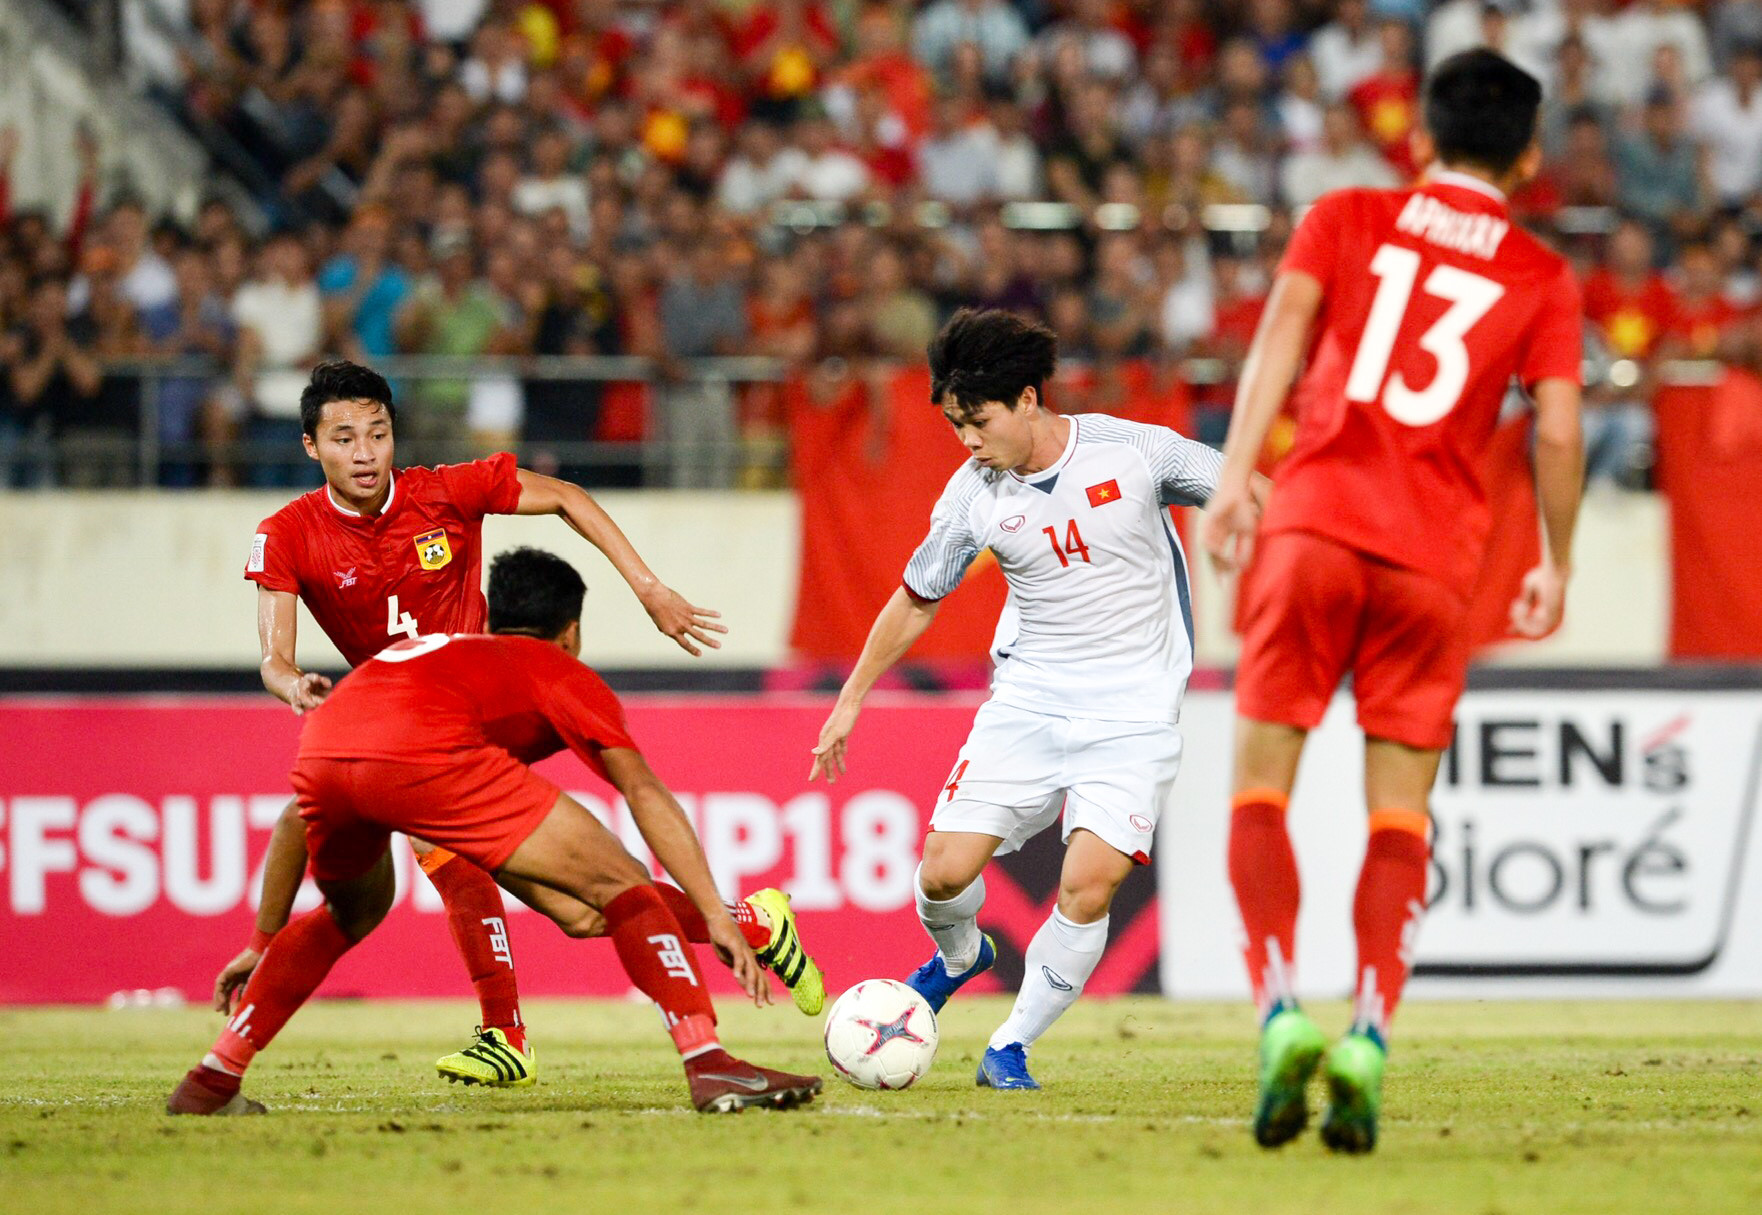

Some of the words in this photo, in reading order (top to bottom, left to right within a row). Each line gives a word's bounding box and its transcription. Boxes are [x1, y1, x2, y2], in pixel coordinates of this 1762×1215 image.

[1344, 243, 1506, 427] 13
[1042, 518, 1091, 568] 14
[387, 594, 419, 640] 4
[482, 917, 514, 970] FBT
[647, 933, 698, 987] FBT
